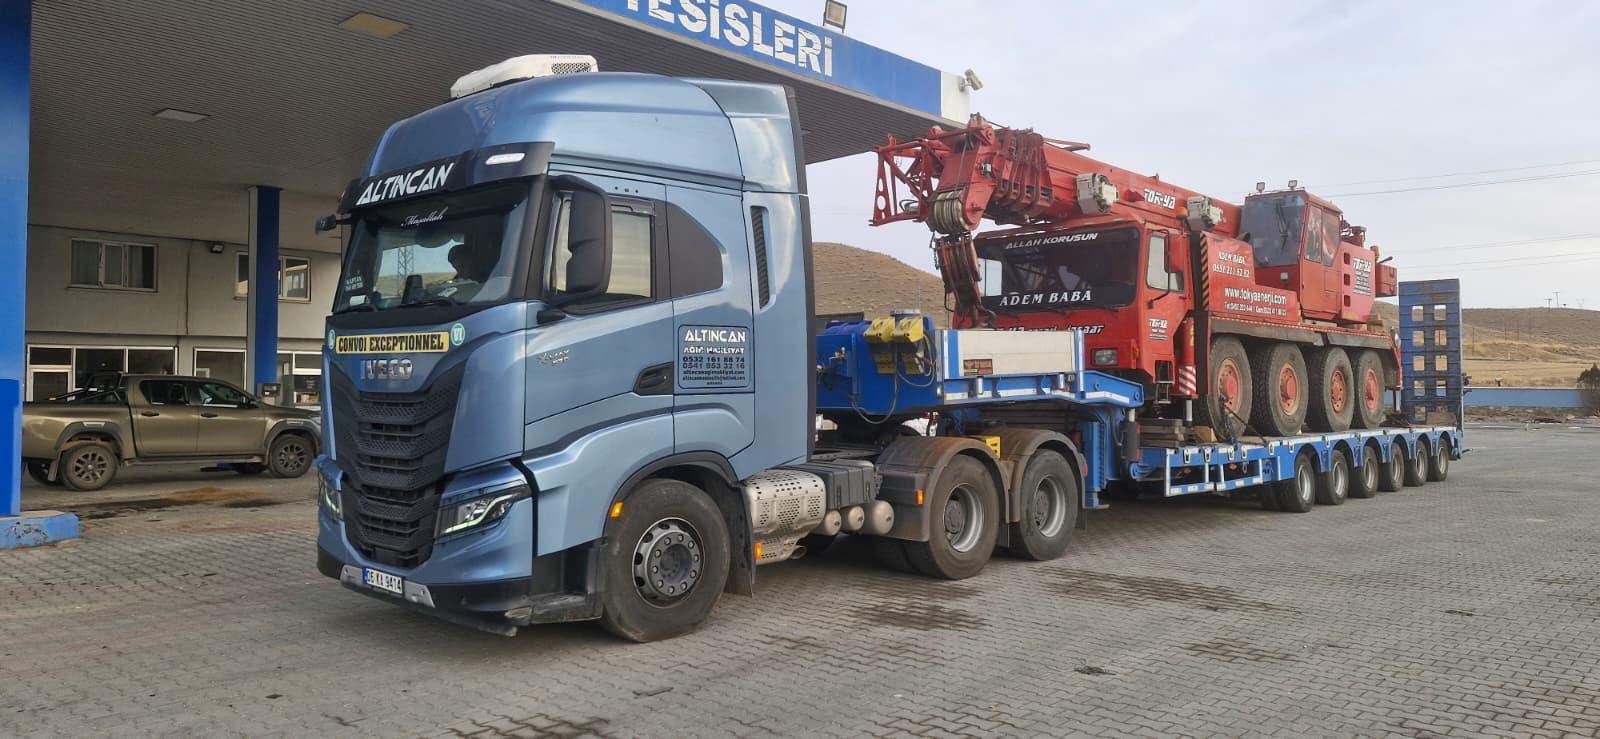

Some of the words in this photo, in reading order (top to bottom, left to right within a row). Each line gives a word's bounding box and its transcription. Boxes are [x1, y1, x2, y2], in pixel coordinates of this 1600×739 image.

[356, 162, 455, 206] ALTINCAN
[1006, 239, 1042, 250] ALLAH
[1042, 232, 1099, 246] KORUSUN
[1000, 294, 1042, 306] ADEM
[1049, 290, 1092, 303] BABA
[370, 333, 444, 352] EXCEPTIONNEL
[684, 329, 746, 342] ALTINCAN
[360, 358, 413, 379] IVECO
